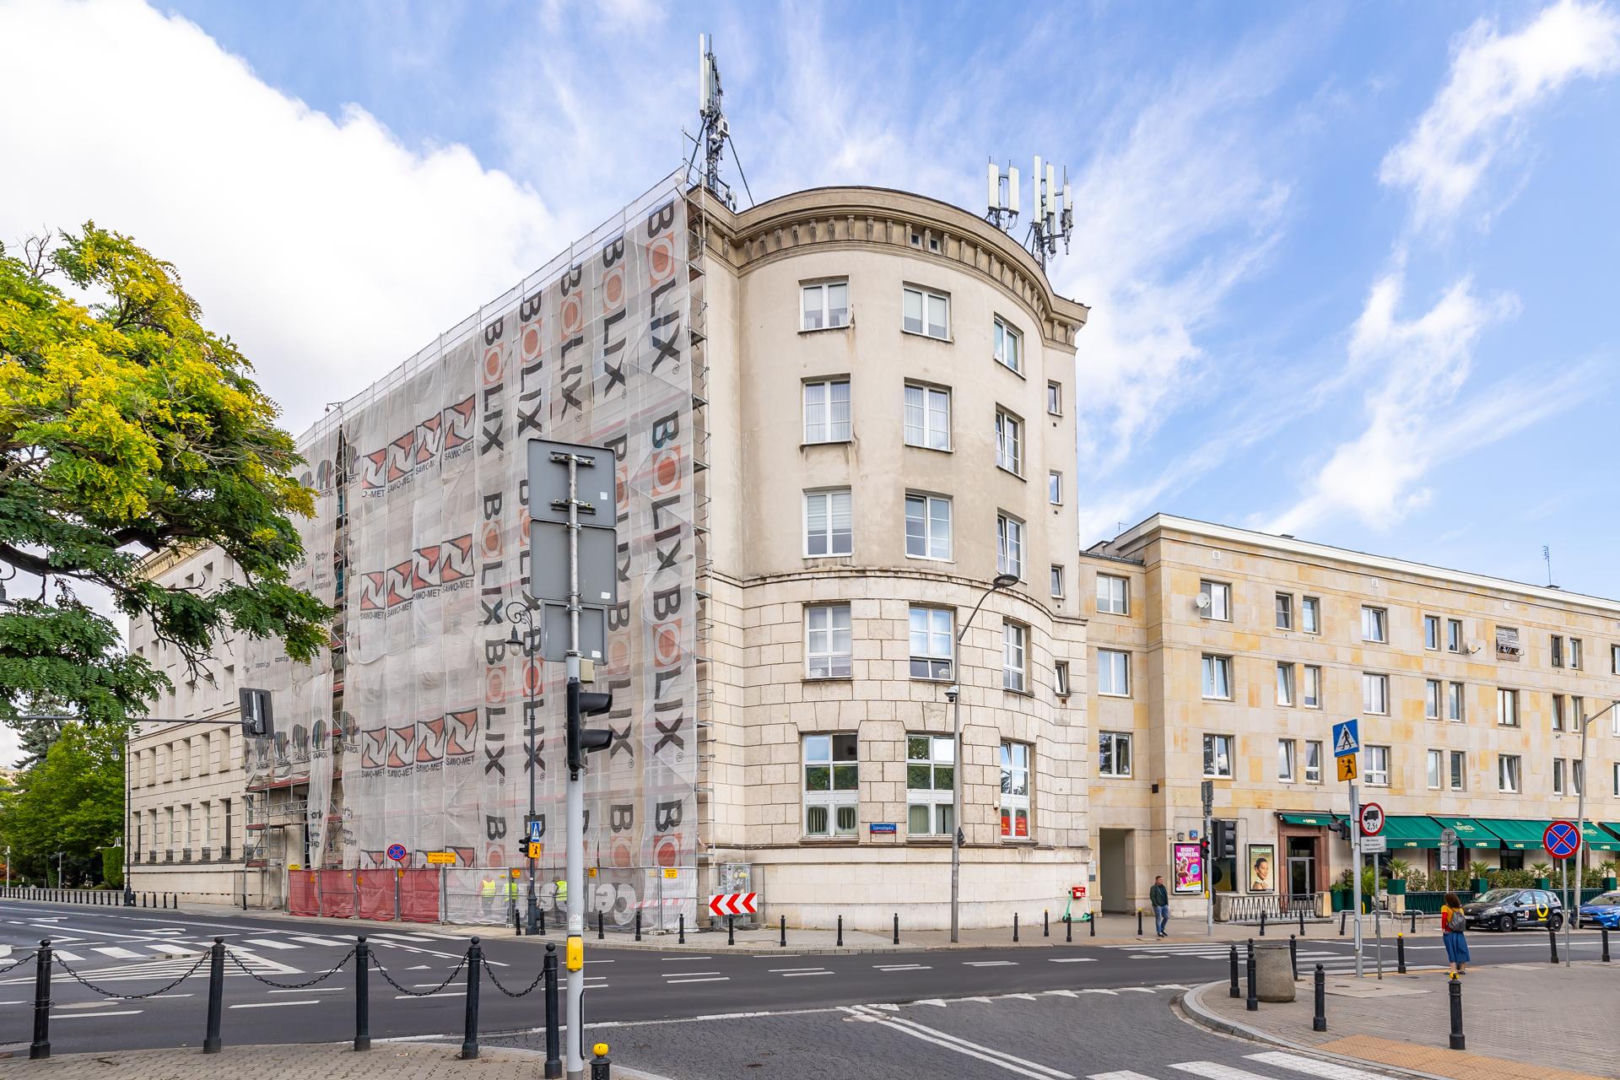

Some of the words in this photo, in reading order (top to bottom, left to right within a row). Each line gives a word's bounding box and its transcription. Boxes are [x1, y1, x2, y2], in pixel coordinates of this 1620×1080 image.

[516, 290, 543, 437] BOLIX
[560, 263, 584, 421] BOLIX
[602, 235, 627, 398] BOLIX
[646, 202, 681, 374] BOLIX
[481, 315, 504, 456] BOLIX
[481, 492, 504, 626] BOLIX
[651, 410, 683, 584] BOLIX
[485, 638, 507, 777] BOLIX
[522, 627, 546, 774] BOLIX
[607, 600, 634, 760] BOLIX
[652, 584, 685, 755] BOLIX
